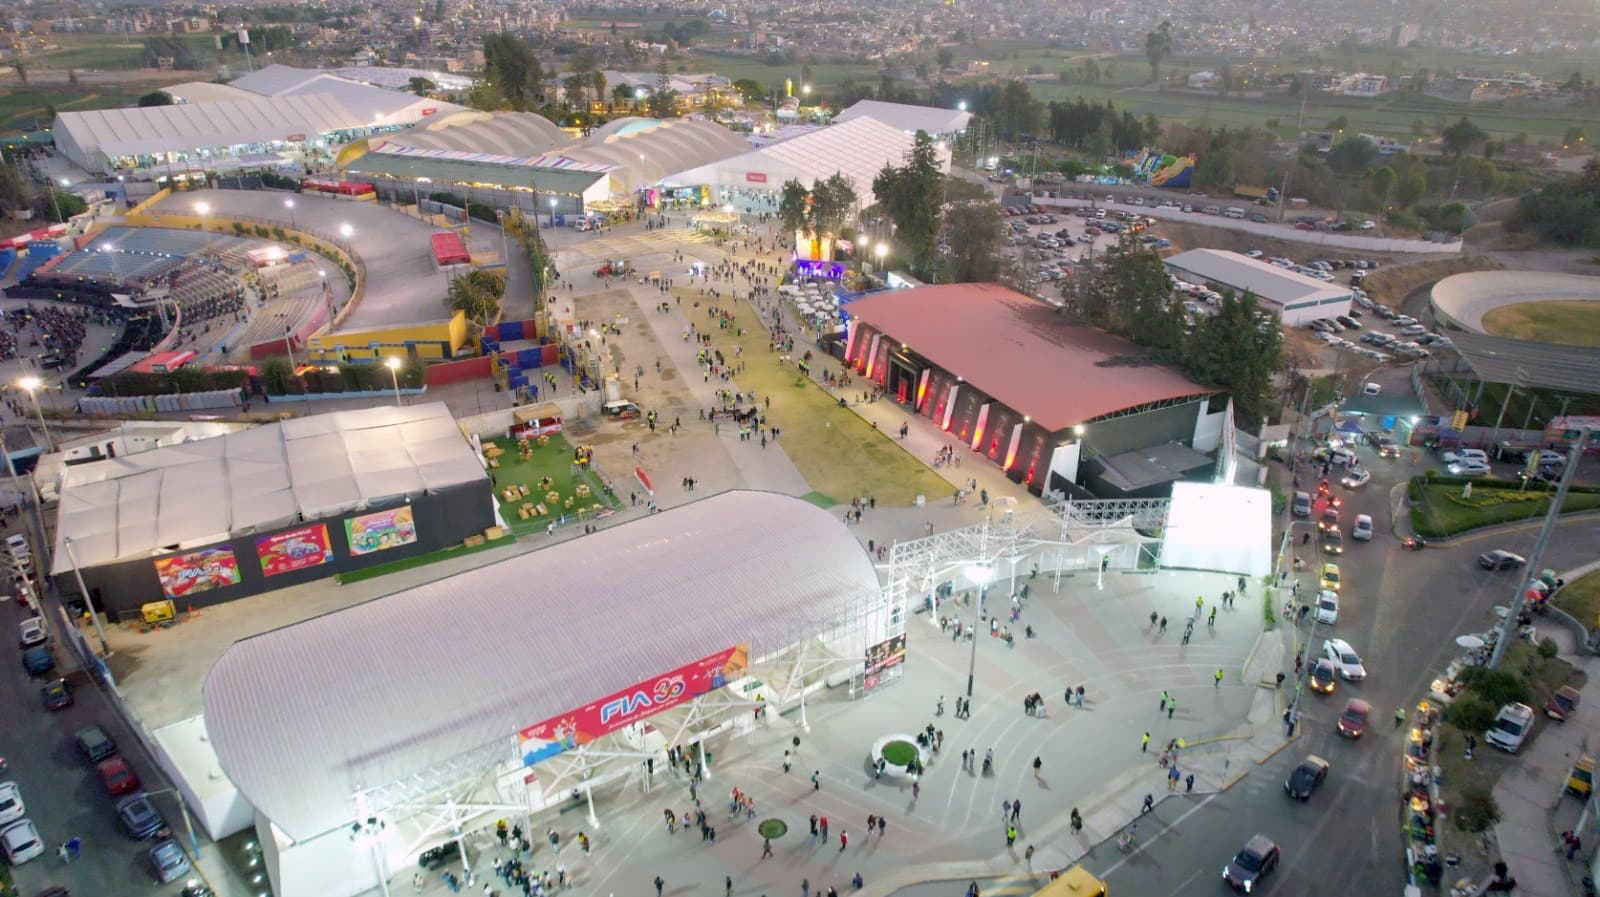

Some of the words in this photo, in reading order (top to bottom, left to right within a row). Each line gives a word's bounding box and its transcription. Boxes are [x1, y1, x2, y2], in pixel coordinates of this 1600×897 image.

[178, 567, 205, 581] FIA
[601, 690, 652, 725] FIA
[653, 677, 685, 703] 30
